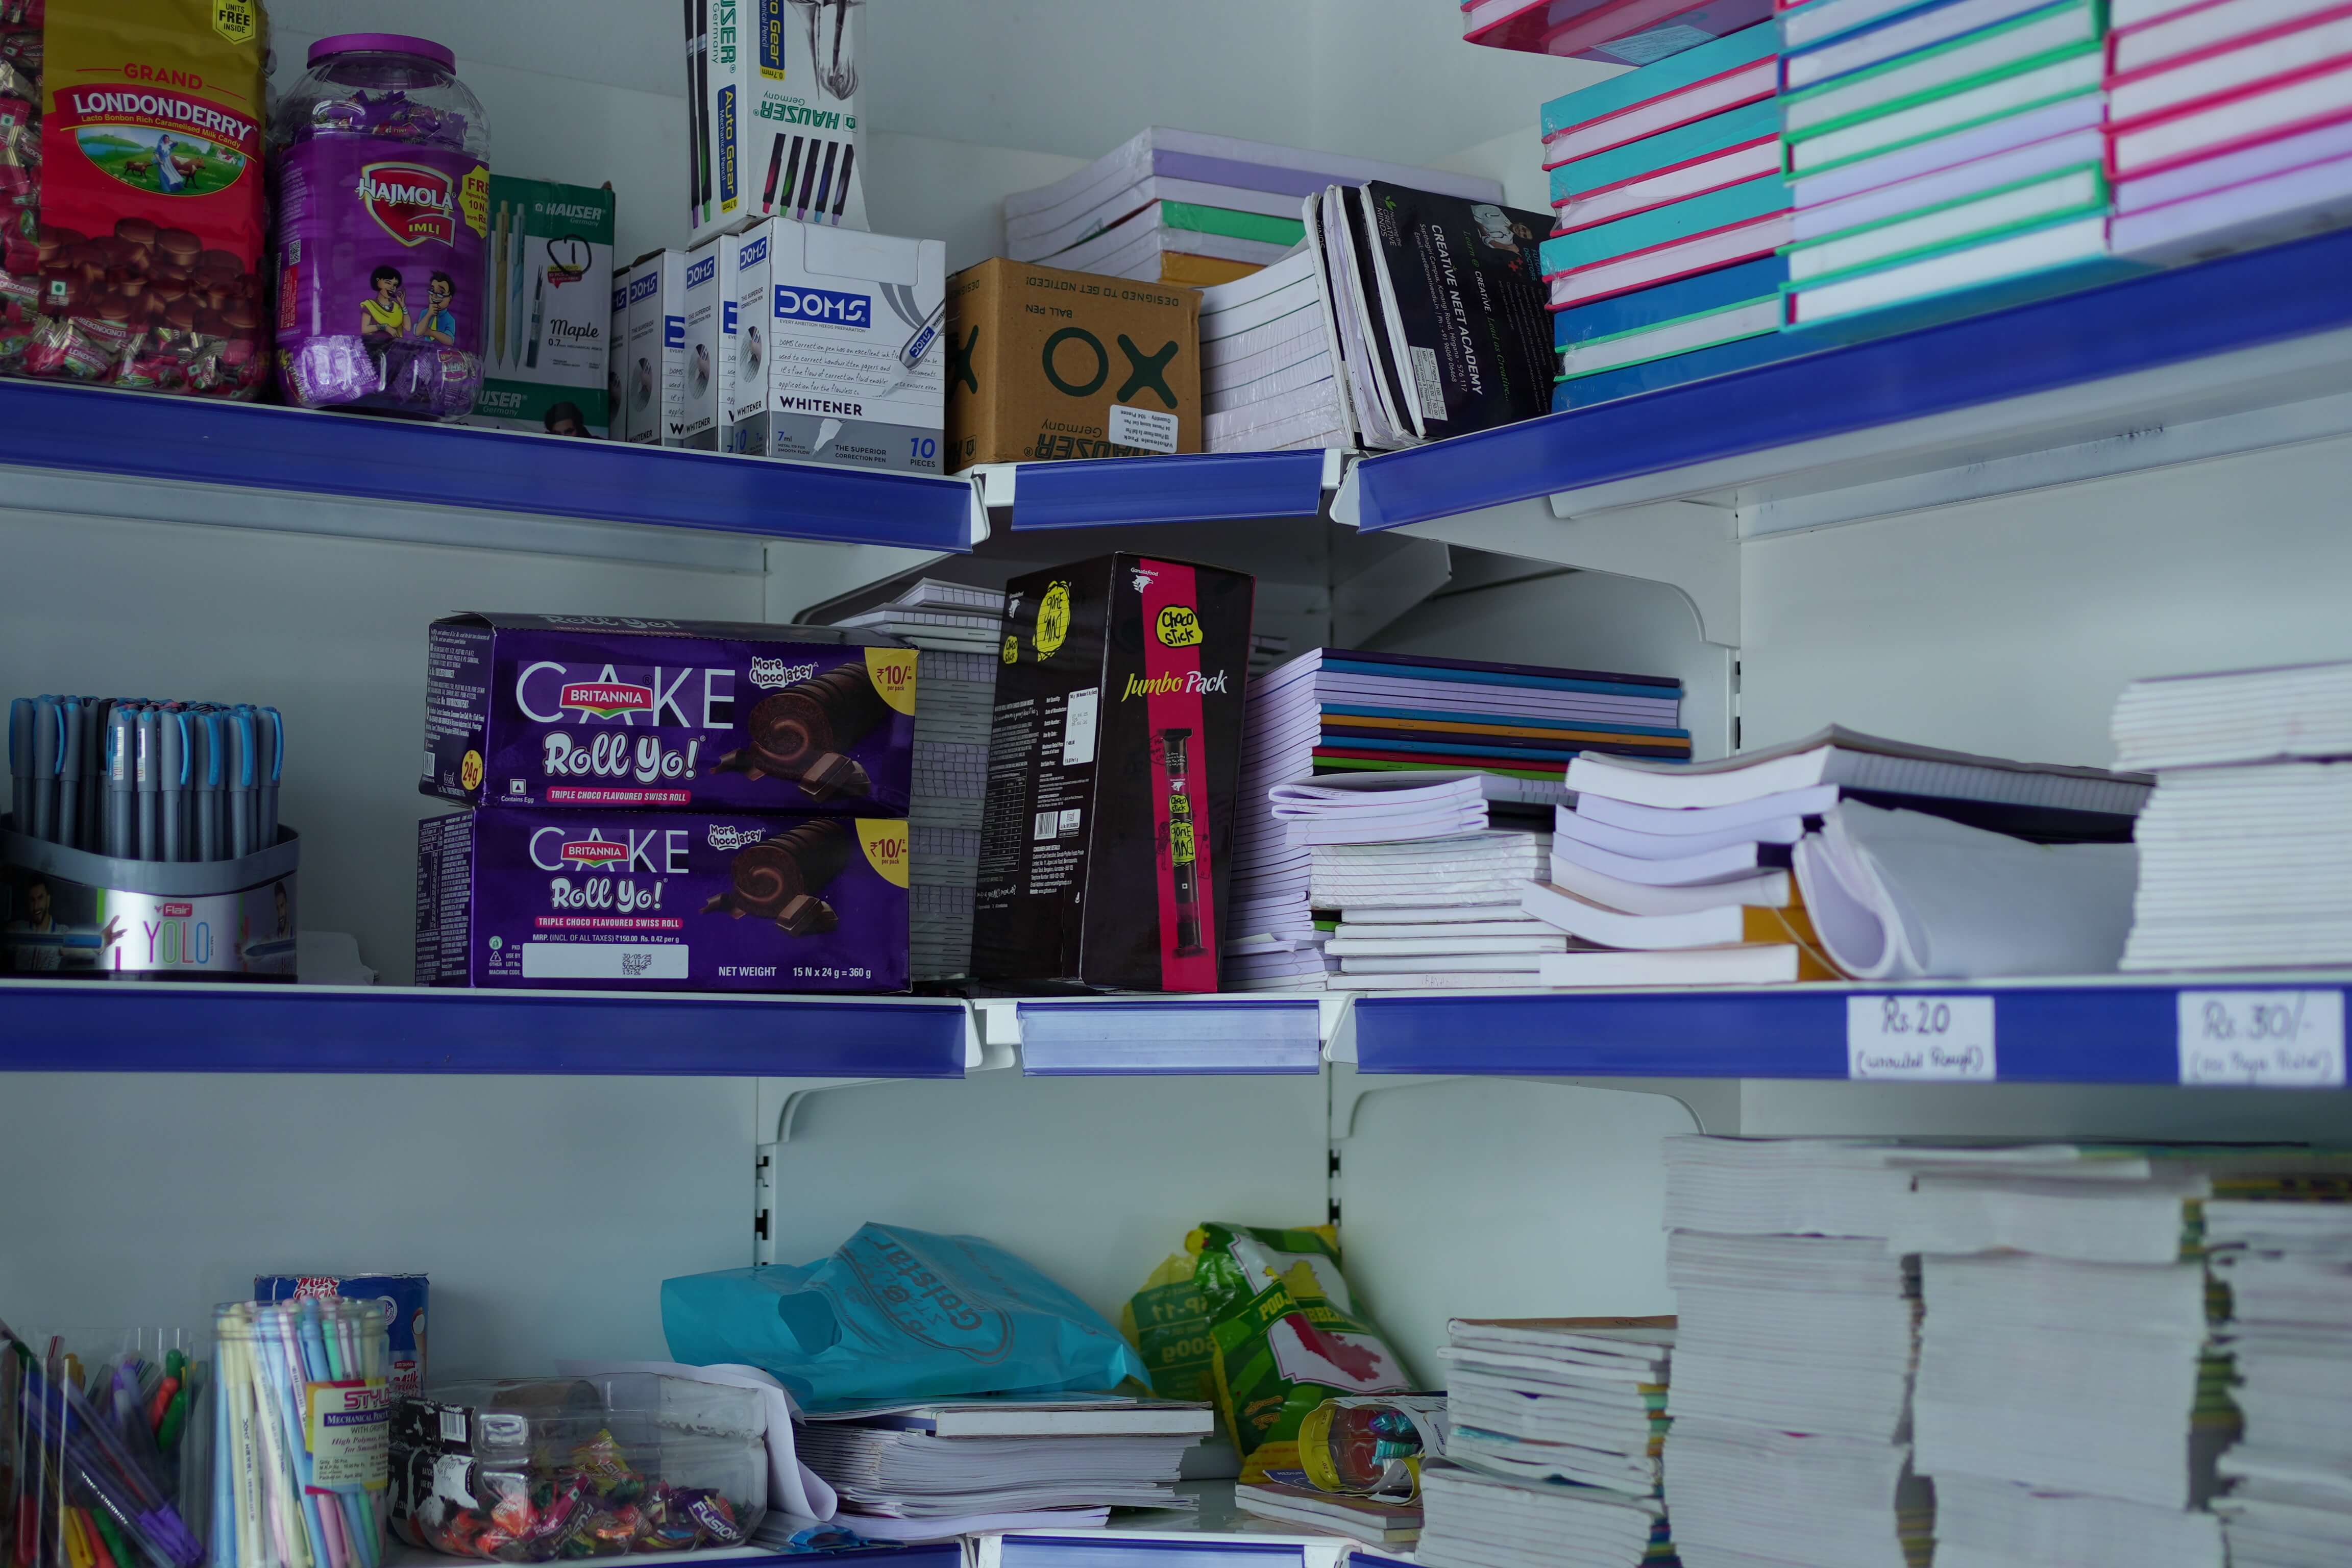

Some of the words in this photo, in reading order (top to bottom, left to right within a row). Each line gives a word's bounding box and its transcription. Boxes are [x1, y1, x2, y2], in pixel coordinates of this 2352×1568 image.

[226, 3, 244, 13] UNITS
[219, 11, 250, 27] FREE
[224, 23, 246, 33] INSIDE
[769, 19, 779, 66] Gear
[124, 63, 203, 90] GRAND
[762, 68, 783, 79] 0.7mm
[764, 90, 805, 106] Germany
[72, 93, 252, 142] LONDONDERRY
[725, 90, 733, 140] Auto
[760, 101, 840, 130] HAUSER
[136, 115, 153, 124] Rich
[155, 118, 200, 134] Caramelised
[202, 128, 216, 140] Milk
[218, 134, 240, 149] Candy
[726, 145, 735, 194] Gear
[355, 178, 454, 210] HAJMOLA
[546, 203, 603, 220] HAUSER
[409, 223, 439, 235] IMLI
[570, 217, 600, 228] Germany
[1376, 207, 1387, 237] MINDS
[1383, 209, 1397, 246] CREATIVE
[1418, 223, 1434, 255] Sapthagiri
[741, 240, 766, 266] DOMS
[1431, 224, 1458, 286] CREATIVE
[688, 260, 714, 286] DOMS
[1426, 256, 1442, 283] Campus,
[1523, 248, 1537, 282] DOCTORS
[631, 276, 656, 301] DOMS
[1026, 276, 1075, 292] NOTICED!
[1080, 284, 1099, 295] GET
[1104, 287, 1117, 298] TO
[779, 290, 867, 322] DOMS
[1121, 290, 1178, 307] DESIGNED
[1436, 285, 1449, 311] Kanangi
[1449, 290, 1466, 325] NEET
[1025, 304, 1045, 315] PEN
[1049, 306, 1072, 318] BALL
[550, 318, 600, 342] Maple
[835, 325, 866, 333] PREPARATION
[1443, 312, 1453, 331] Road,
[910, 329, 932, 356] DOMS
[1446, 332, 1460, 359] Hirgana
[1457, 326, 1483, 396] ACADEMY
[1456, 364, 1465, 378] 576
[778, 381, 808, 390] application
[821, 383, 829, 392] the
[830, 383, 853, 395] flawless
[1459, 379, 1468, 393] 117
[483, 406, 519, 417] Germany
[737, 401, 762, 417] WHITENER
[780, 396, 863, 416] WHITENER
[687, 417, 710, 433] WHITENER
[1041, 419, 1102, 438] Germany
[851, 446, 887, 455] SUPERIOR
[911, 437, 936, 459] 10
[1141, 438, 1173, 448] Wholesale
[835, 453, 872, 461] CORRECTION
[910, 459, 936, 468] PIECES
[1131, 568, 1159, 576] Garudafood
[538, 615, 619, 626] Roll
[619, 617, 680, 629] Yo!
[753, 657, 782, 670] More
[750, 663, 813, 684] Chocolatey
[516, 660, 736, 730] CAKE
[1121, 671, 1183, 702] Jumbo
[1186, 670, 1228, 695] Pack
[571, 690, 643, 704] BRITANNIA
[544, 732, 631, 776] Roll
[635, 738, 700, 783] Yo!
[462, 761, 479, 787] 24g
[551, 790, 575, 799] TRIPLE
[577, 792, 601, 800] CHOCO
[603, 792, 643, 800] FLAVOURED
[644, 793, 667, 801] SWISS
[708, 829, 761, 846] Chocolatey
[710, 825, 736, 835] More
[529, 826, 689, 873] CAKE
[569, 846, 621, 856] BRITANNIA
[551, 877, 613, 909] Roll
[616, 879, 663, 912] Yo!
[165, 904, 189, 915] Flair
[566, 918, 591, 926] CHOCO
[593, 919, 633, 927] FLAVOURED
[635, 919, 659, 927] SWISS
[662, 919, 679, 927] ROLL
[143, 920, 210, 965] YOLO
[719, 966, 736, 977] NET
[739, 966, 777, 977] WEIGHT
[793, 967, 803, 977] 15
[805, 967, 812, 977] N
[822, 967, 832, 977] 24
[834, 970, 840, 979] g
[849, 967, 863, 977] 360
[865, 970, 871, 979] g
[1918, 1001, 1951, 1034] 20
[692, 1500, 745, 1541] FUSION
